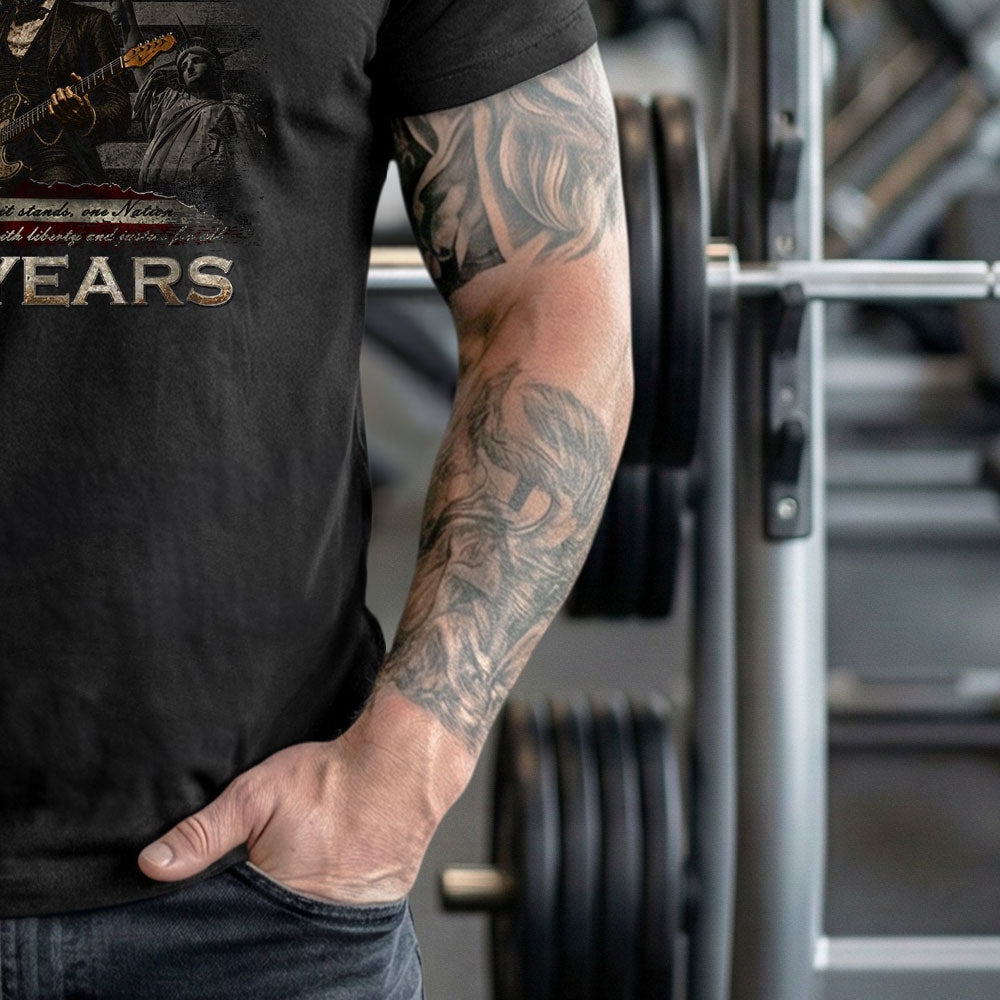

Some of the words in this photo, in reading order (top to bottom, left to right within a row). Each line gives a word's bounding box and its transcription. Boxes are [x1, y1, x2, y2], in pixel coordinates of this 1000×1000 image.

[18, 201, 75, 218] stands,
[81, 206, 110, 218] one
[111, 199, 175, 219] Nation
[28, 226, 82, 247] liberty
[85, 227, 120, 243] and
